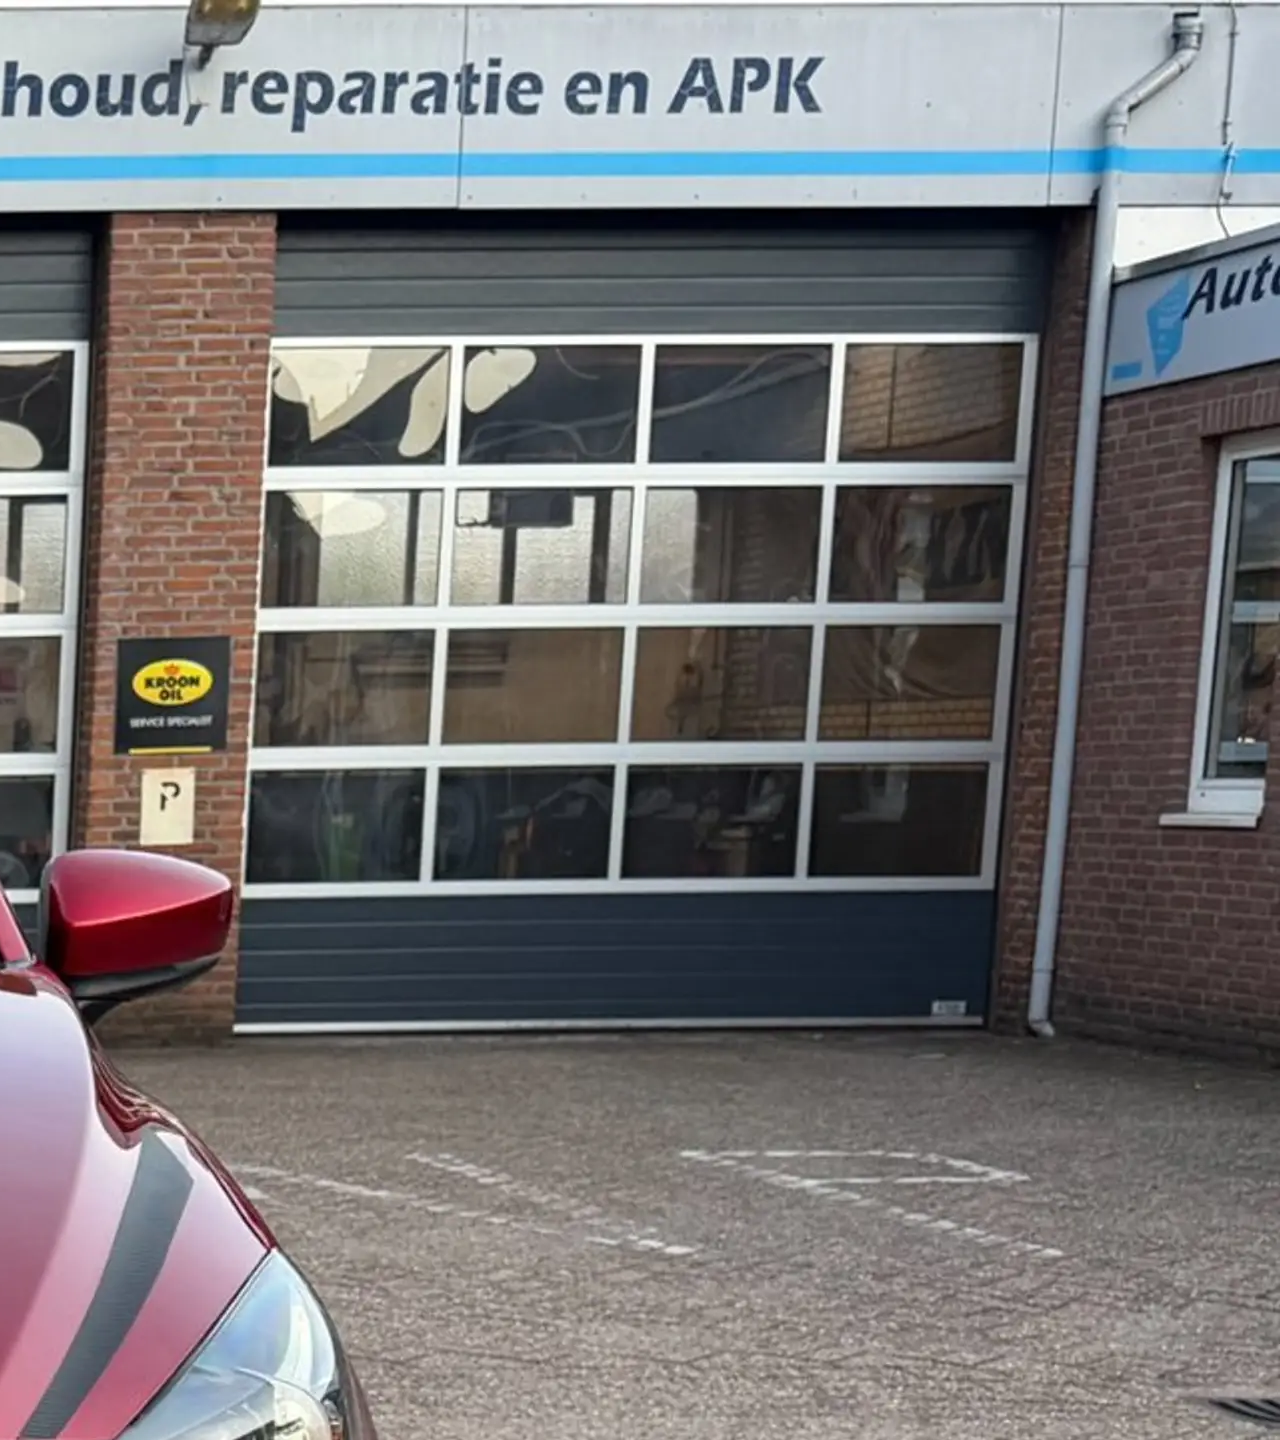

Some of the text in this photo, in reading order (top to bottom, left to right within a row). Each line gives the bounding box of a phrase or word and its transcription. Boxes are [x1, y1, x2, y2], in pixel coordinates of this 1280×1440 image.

[221, 59, 543, 132] reparatie
[564, 71, 649, 115] en
[667, 57, 824, 114] APK
[144, 676, 201, 689] KROON
[159, 689, 183, 701] OIL
